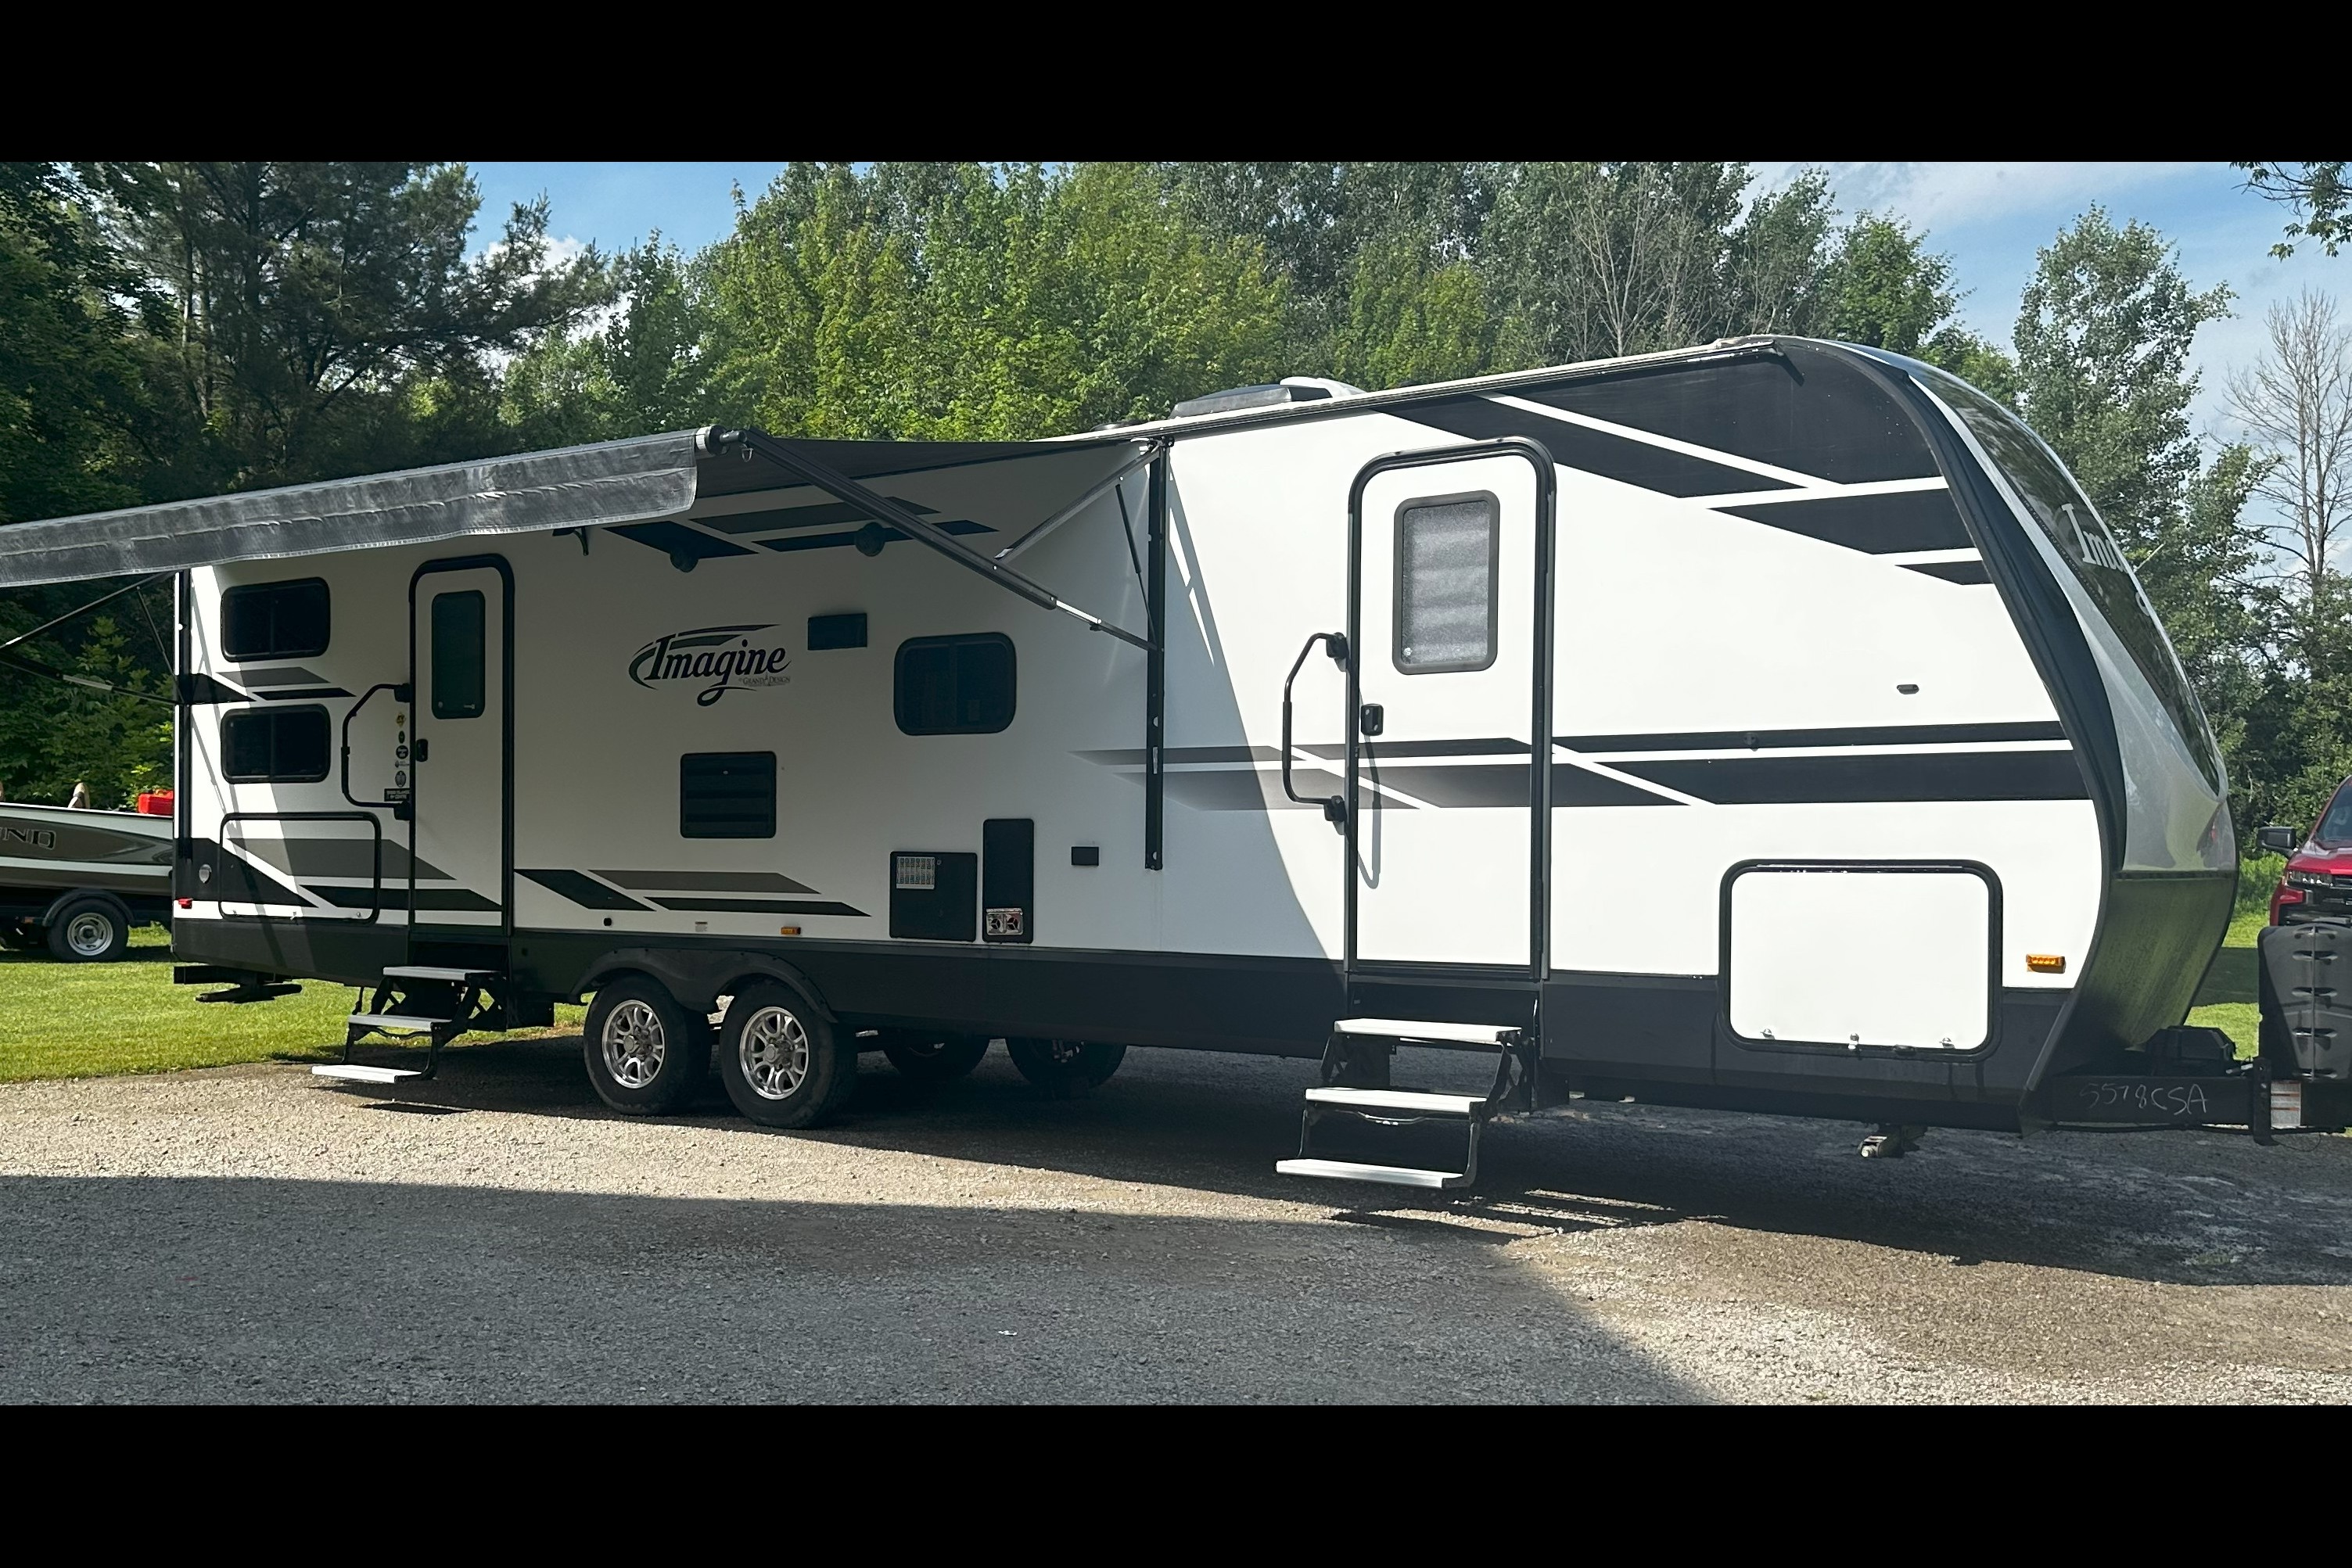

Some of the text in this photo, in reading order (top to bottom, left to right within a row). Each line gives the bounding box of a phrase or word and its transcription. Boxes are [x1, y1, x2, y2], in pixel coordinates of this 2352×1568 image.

[644, 633, 792, 706] Imagine
[770, 675, 791, 685] DESIGN
[0, 827, 56, 850] ND
